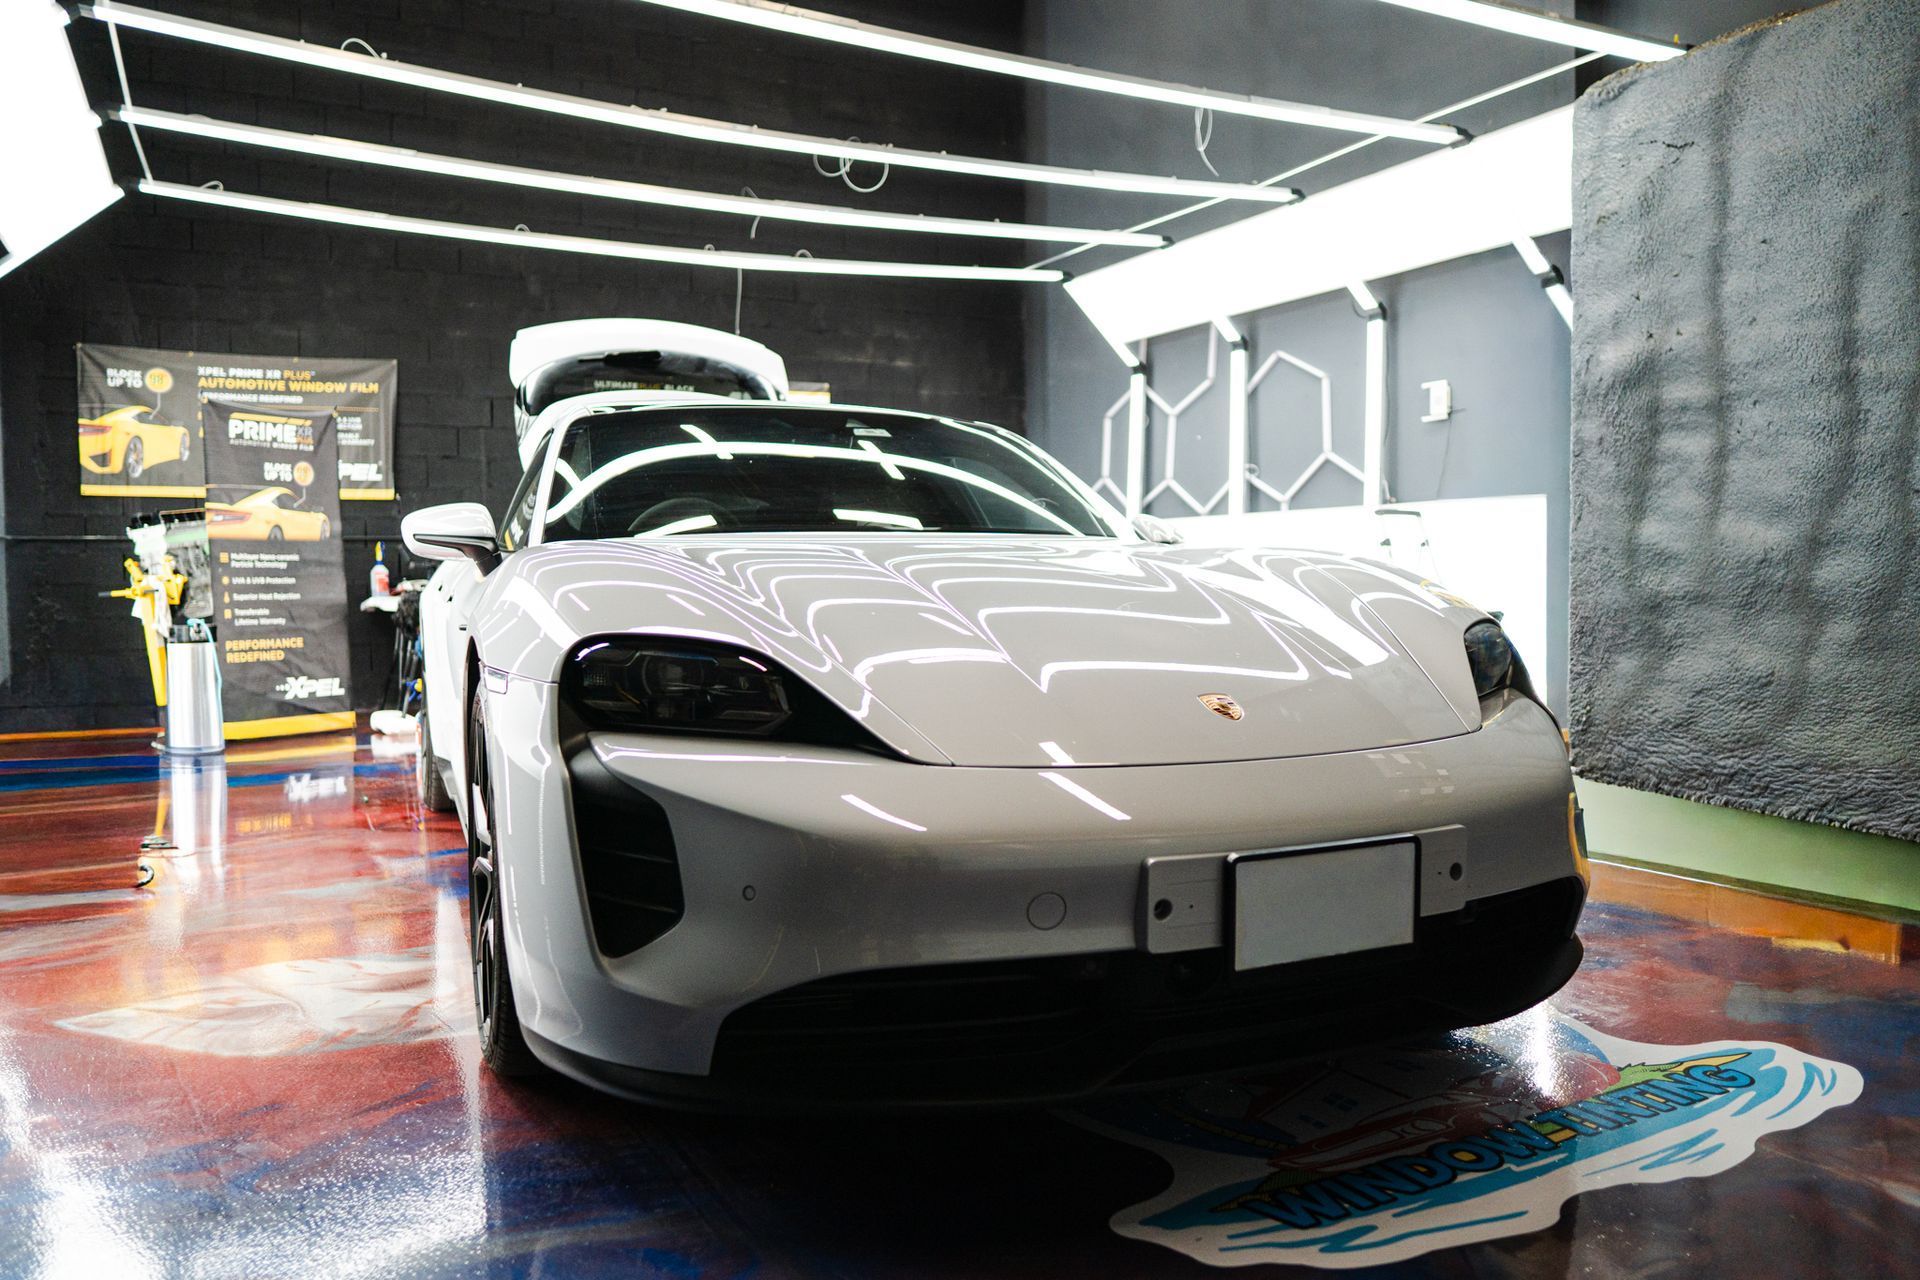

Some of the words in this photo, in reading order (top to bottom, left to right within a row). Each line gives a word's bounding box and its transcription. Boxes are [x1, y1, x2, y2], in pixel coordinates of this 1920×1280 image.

[106, 368, 142, 378] BLOCK
[197, 366, 227, 377] XPEL
[228, 368, 264, 379] PRIME
[107, 377, 124, 387] UP
[197, 376, 286, 391] AUTOMOTIVE
[288, 381, 347, 393] WINDOW
[350, 383, 379, 394] FILM
[228, 418, 297, 443] PRIME
[338, 459, 383, 481] PEL
[225, 637, 304, 651] PERFORMANCE
[226, 649, 286, 664] REDEFINED
[284, 675, 346, 700] XPEL
[1246, 1118, 1561, 1229] WINDOW
